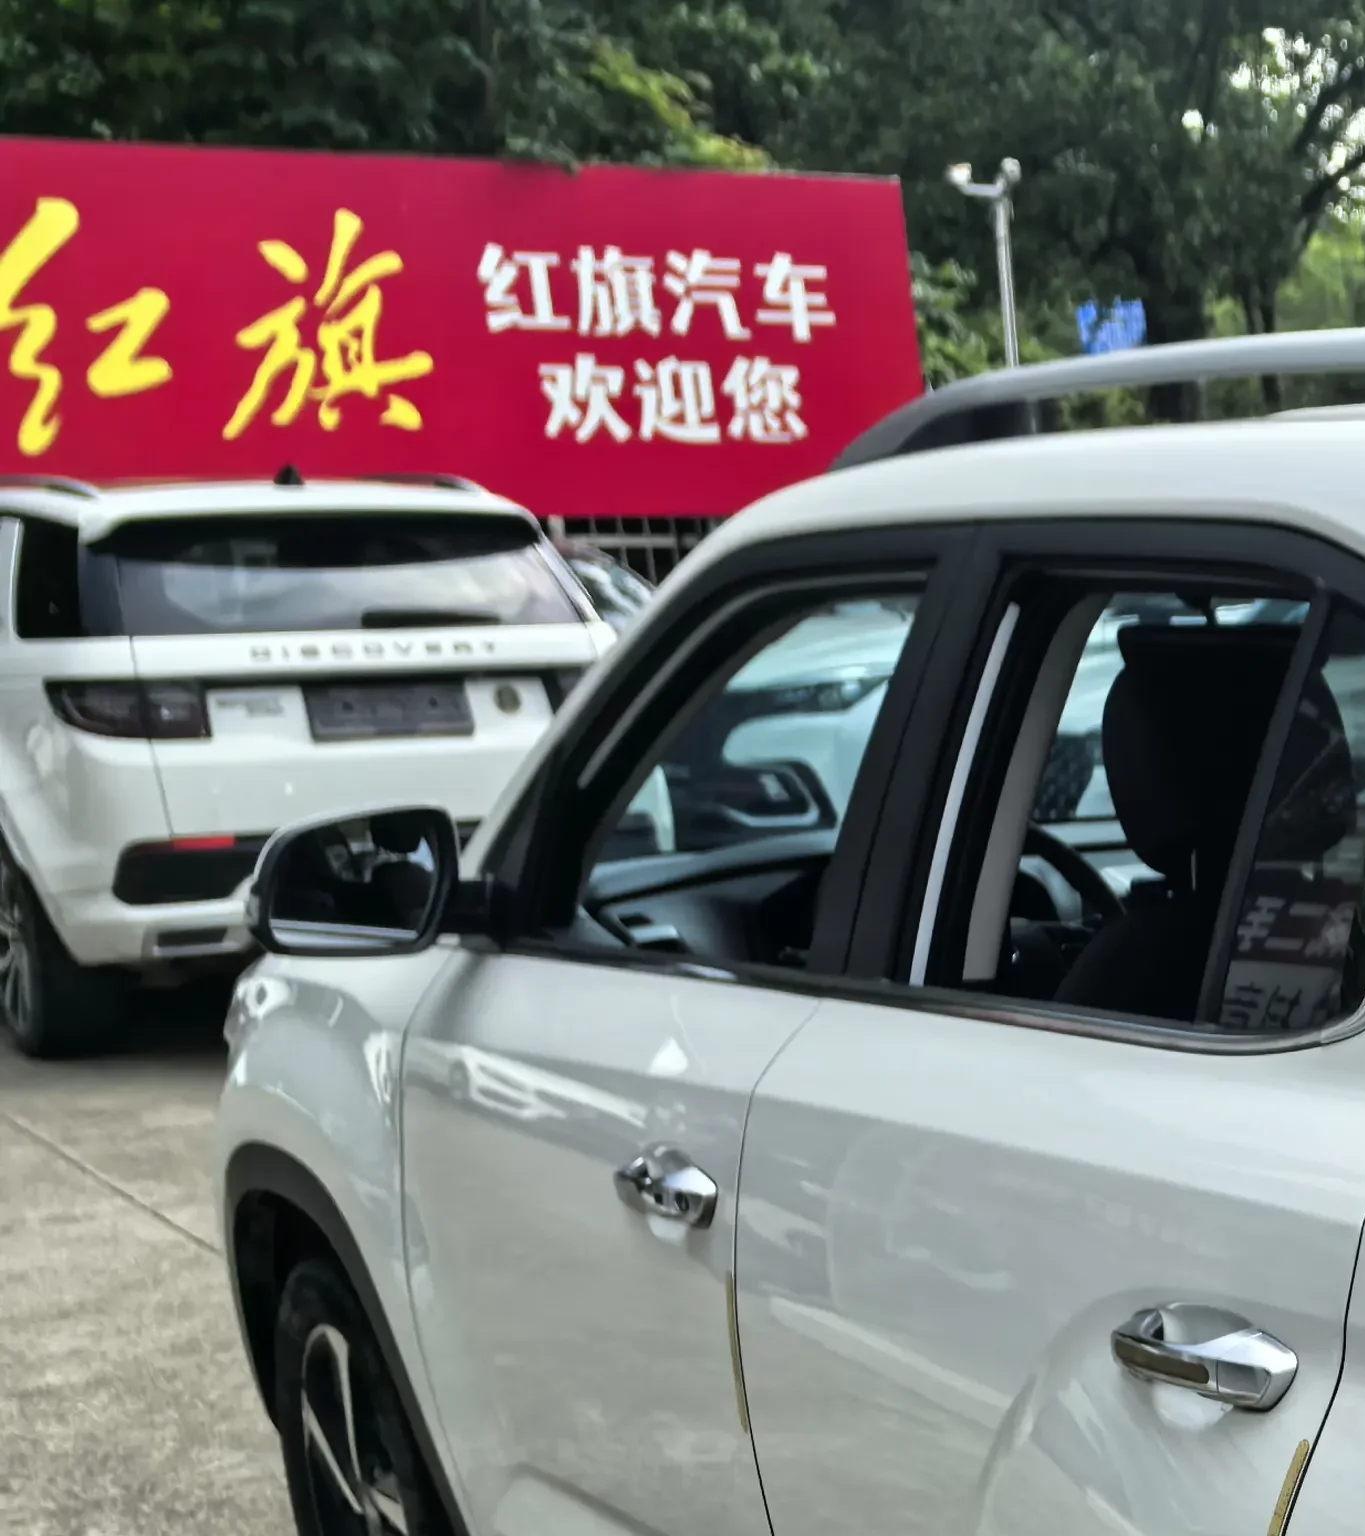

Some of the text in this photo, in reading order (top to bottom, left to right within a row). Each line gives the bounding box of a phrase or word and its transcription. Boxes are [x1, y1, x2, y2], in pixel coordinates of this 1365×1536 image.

[0, 197, 434, 456] 红旗
[477, 242, 836, 342] 红旗汽车
[537, 352, 807, 444] 欢迎您
[249, 638, 497, 662] DISCOVERY
